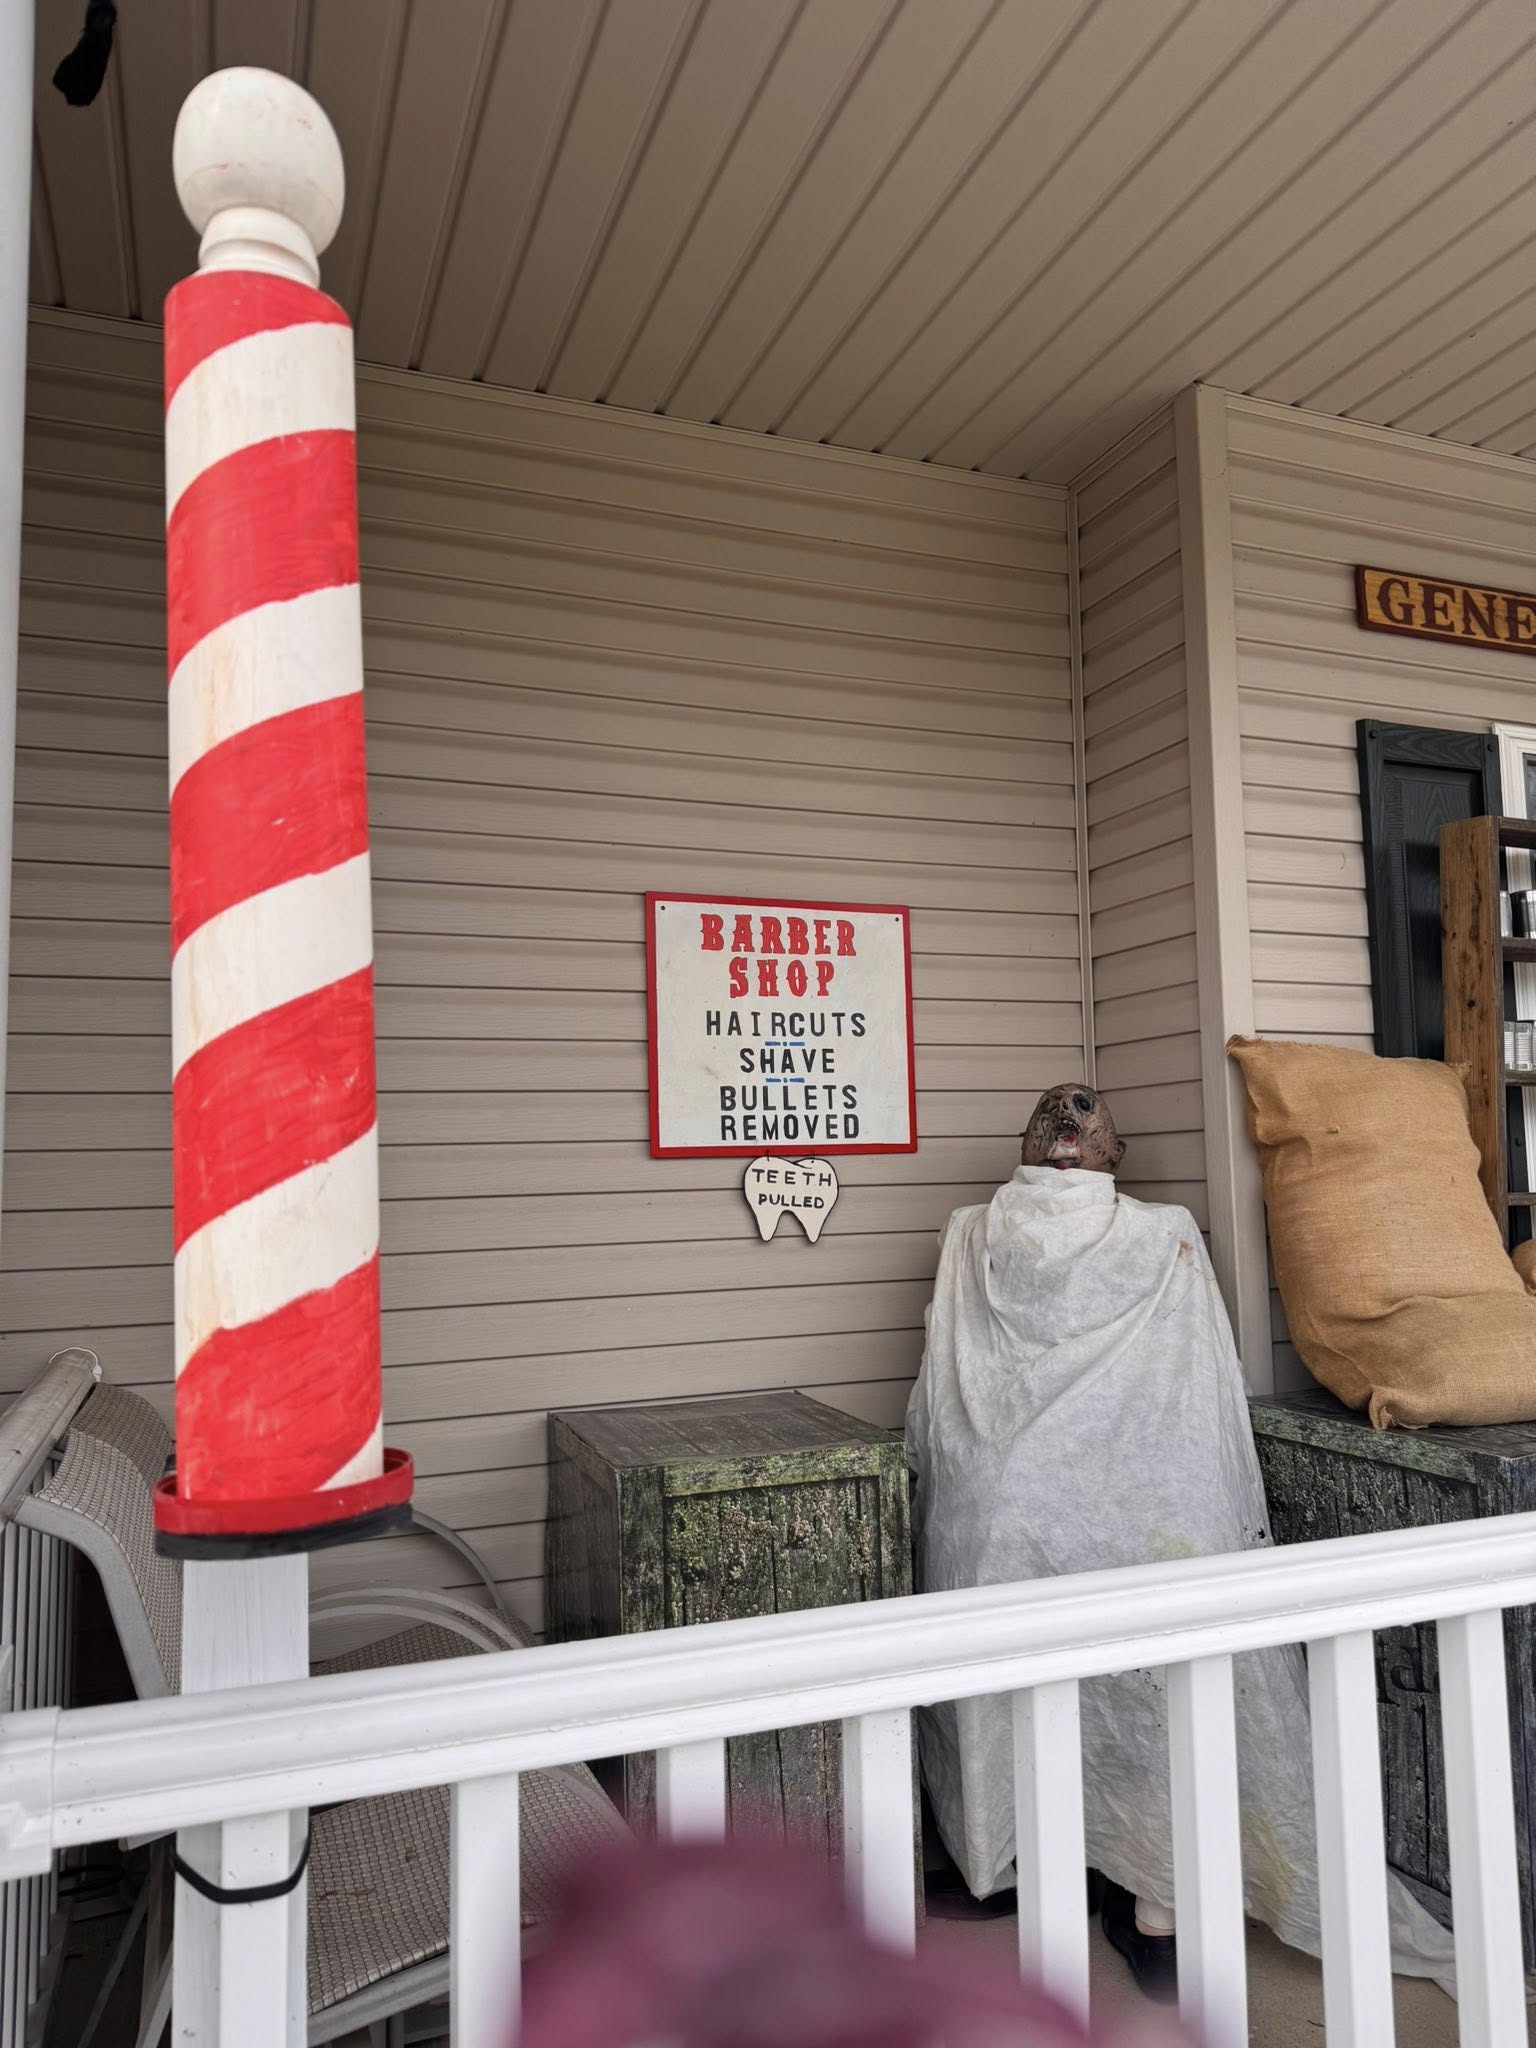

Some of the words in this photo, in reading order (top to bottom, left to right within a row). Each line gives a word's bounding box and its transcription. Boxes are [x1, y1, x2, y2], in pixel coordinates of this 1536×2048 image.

[1376, 578, 1536, 645] GENE
[700, 913, 857, 957] BARBER
[728, 957, 836, 999] SHOP
[706, 1010, 867, 1038] HAIRCUTS
[740, 1048, 836, 1074] SHAVE
[720, 1084, 859, 1112] BULLETS
[721, 1114, 860, 1141] REMOVED
[751, 1168, 833, 1188] TEETH
[758, 1193, 825, 1209] PULLED
